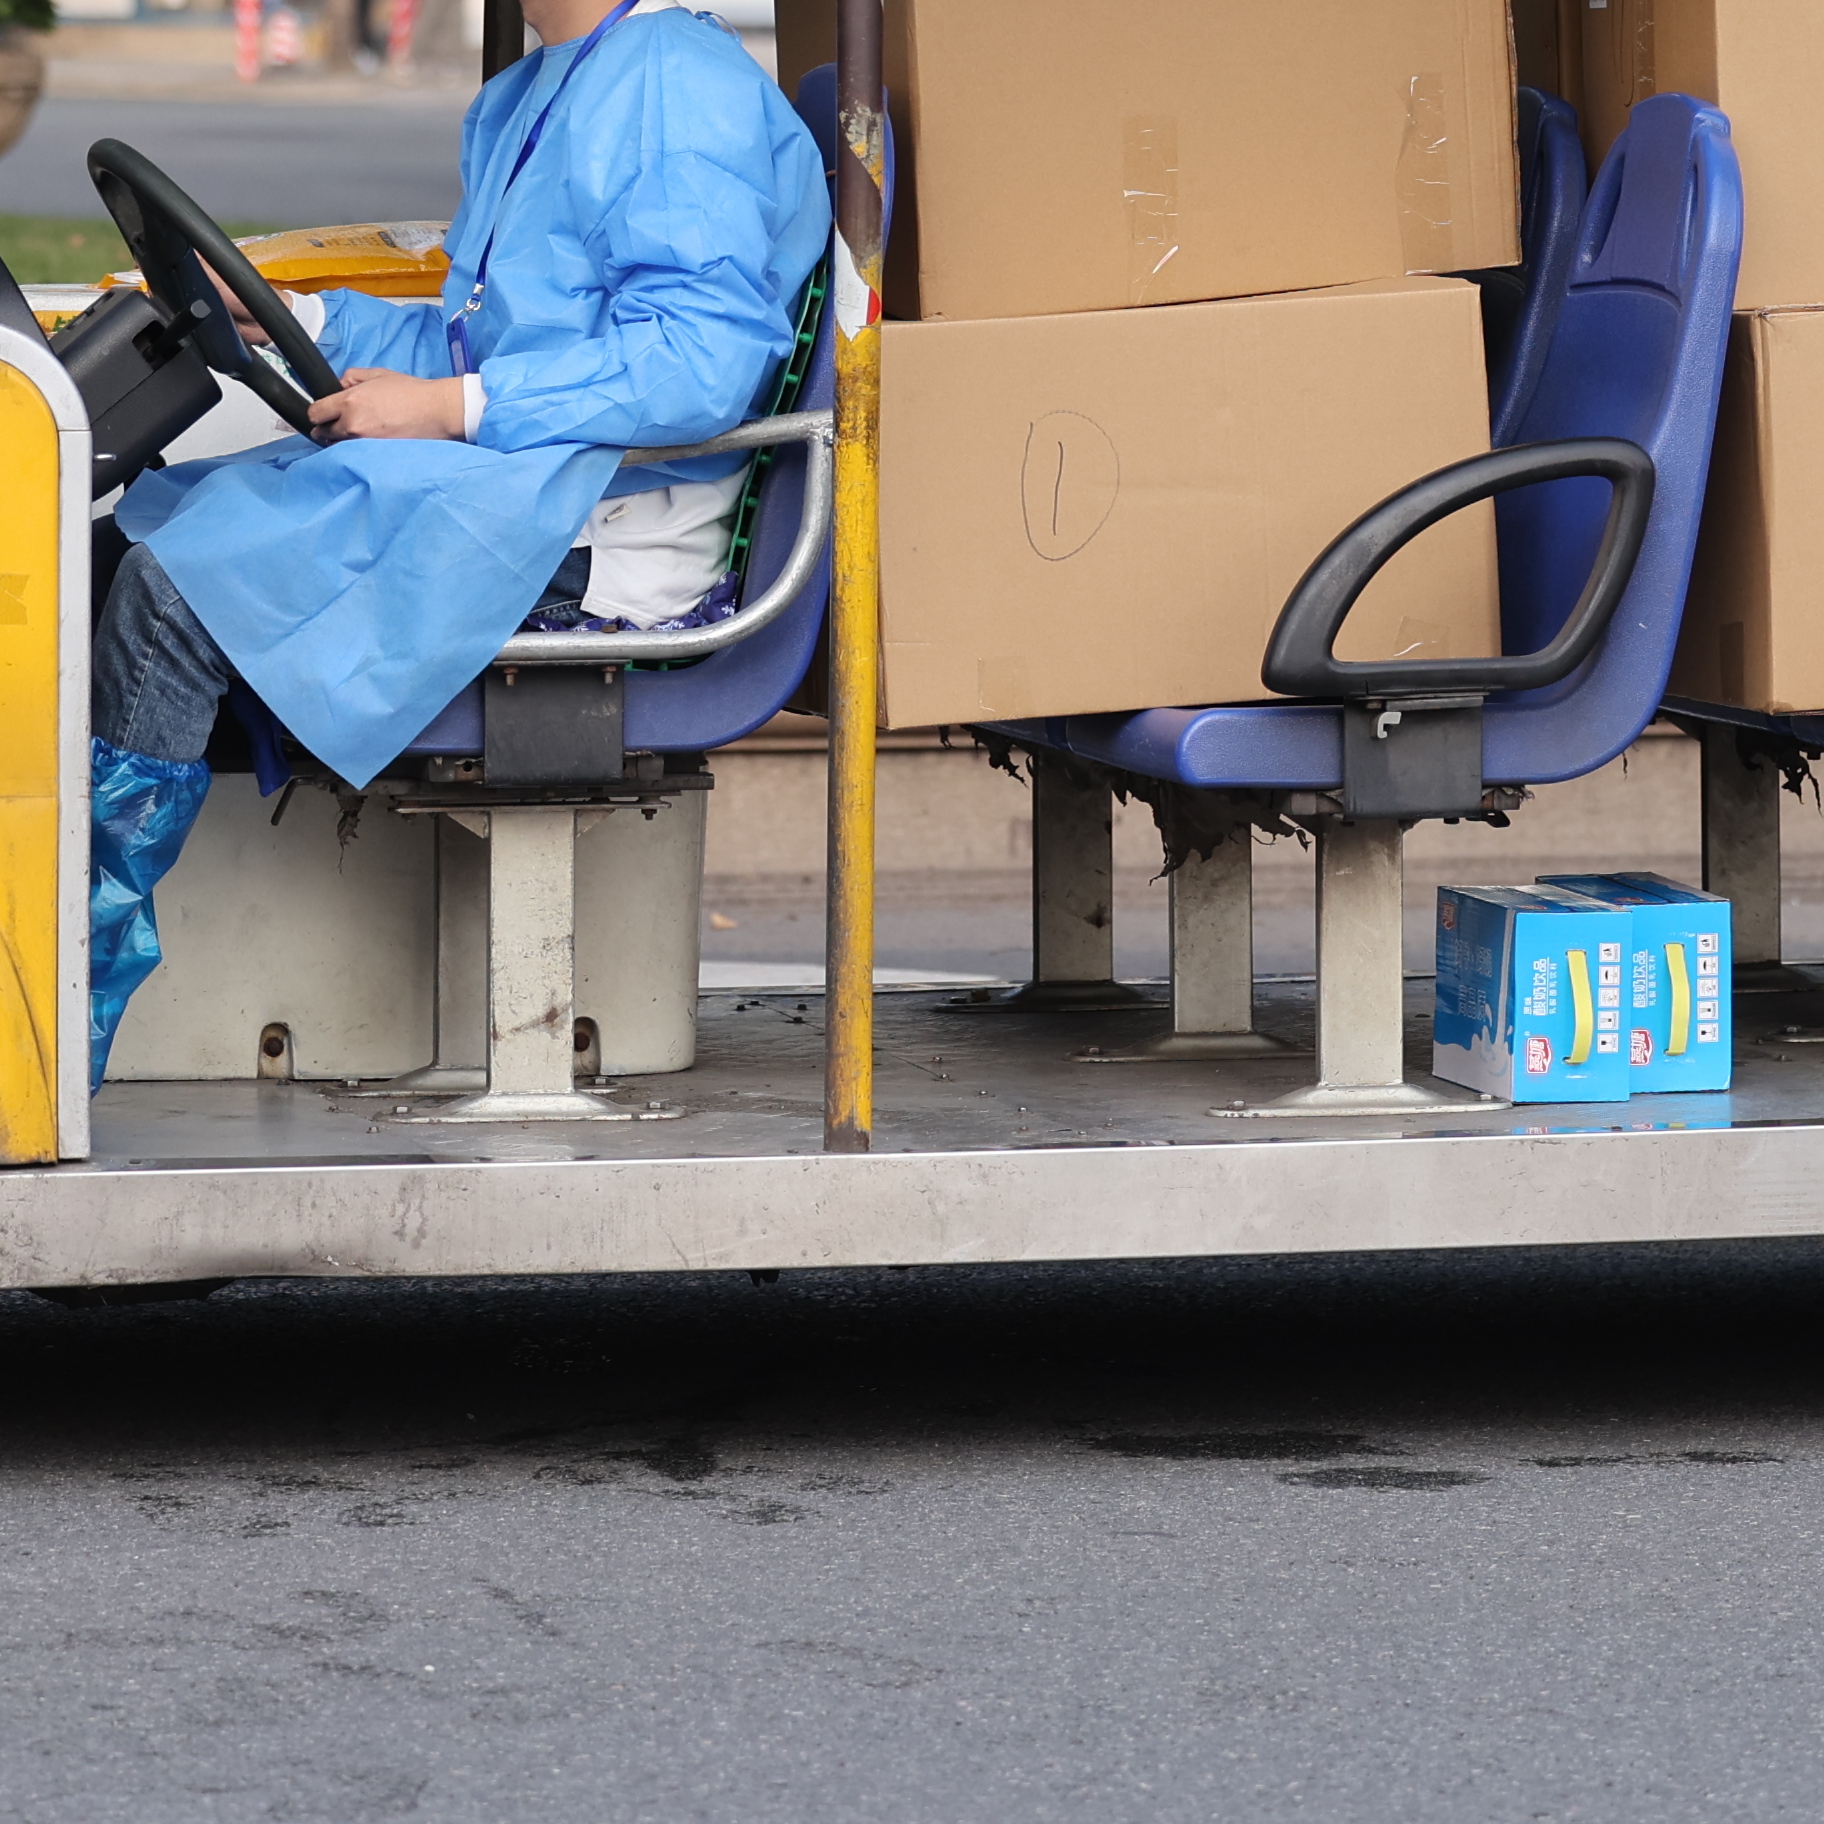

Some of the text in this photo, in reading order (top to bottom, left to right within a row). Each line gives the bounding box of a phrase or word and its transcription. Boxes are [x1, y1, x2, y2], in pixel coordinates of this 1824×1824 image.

[1533, 958, 1547, 1016] 酸奶饮品
[1632, 951, 1646, 1008] 酸奶饮品
